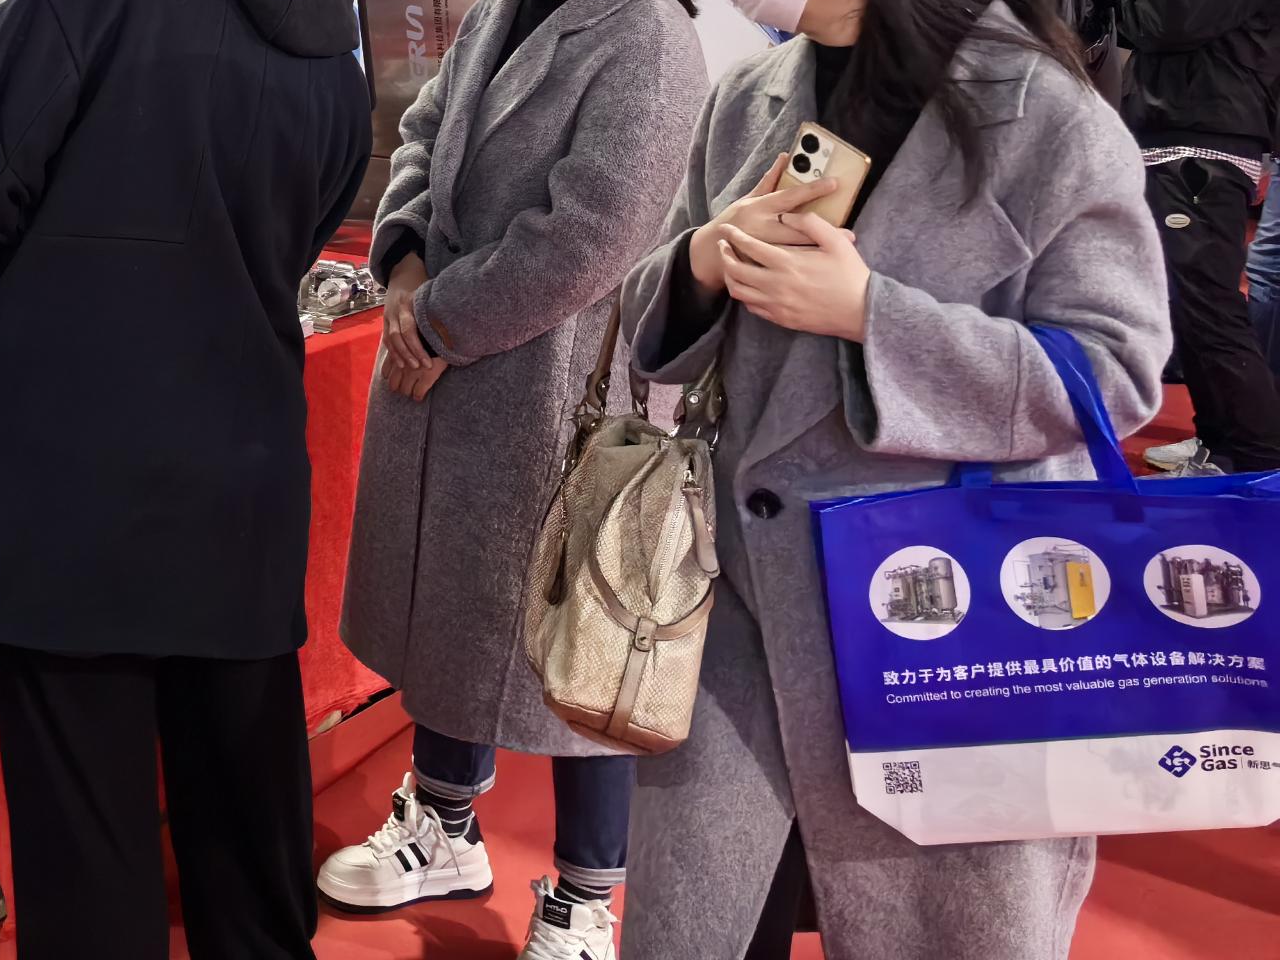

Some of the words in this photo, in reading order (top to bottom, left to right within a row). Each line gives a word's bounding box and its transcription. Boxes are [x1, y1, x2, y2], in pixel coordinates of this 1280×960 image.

[883, 651, 1266, 686] 致力于为客户提供最具价值的气体设备解决方案
[886, 689, 948, 704] Committed
[950, 690, 961, 700] to
[964, 686, 1010, 698] creating
[1012, 683, 1031, 694] the
[1034, 682, 1063, 693] most
[1065, 678, 1115, 691] valuable
[1118, 677, 1140, 689] gas
[1143, 674, 1208, 688] generation
[1211, 674, 1269, 688] solutions
[1199, 744, 1254, 758] Since
[1200, 758, 1238, 772] Gas
